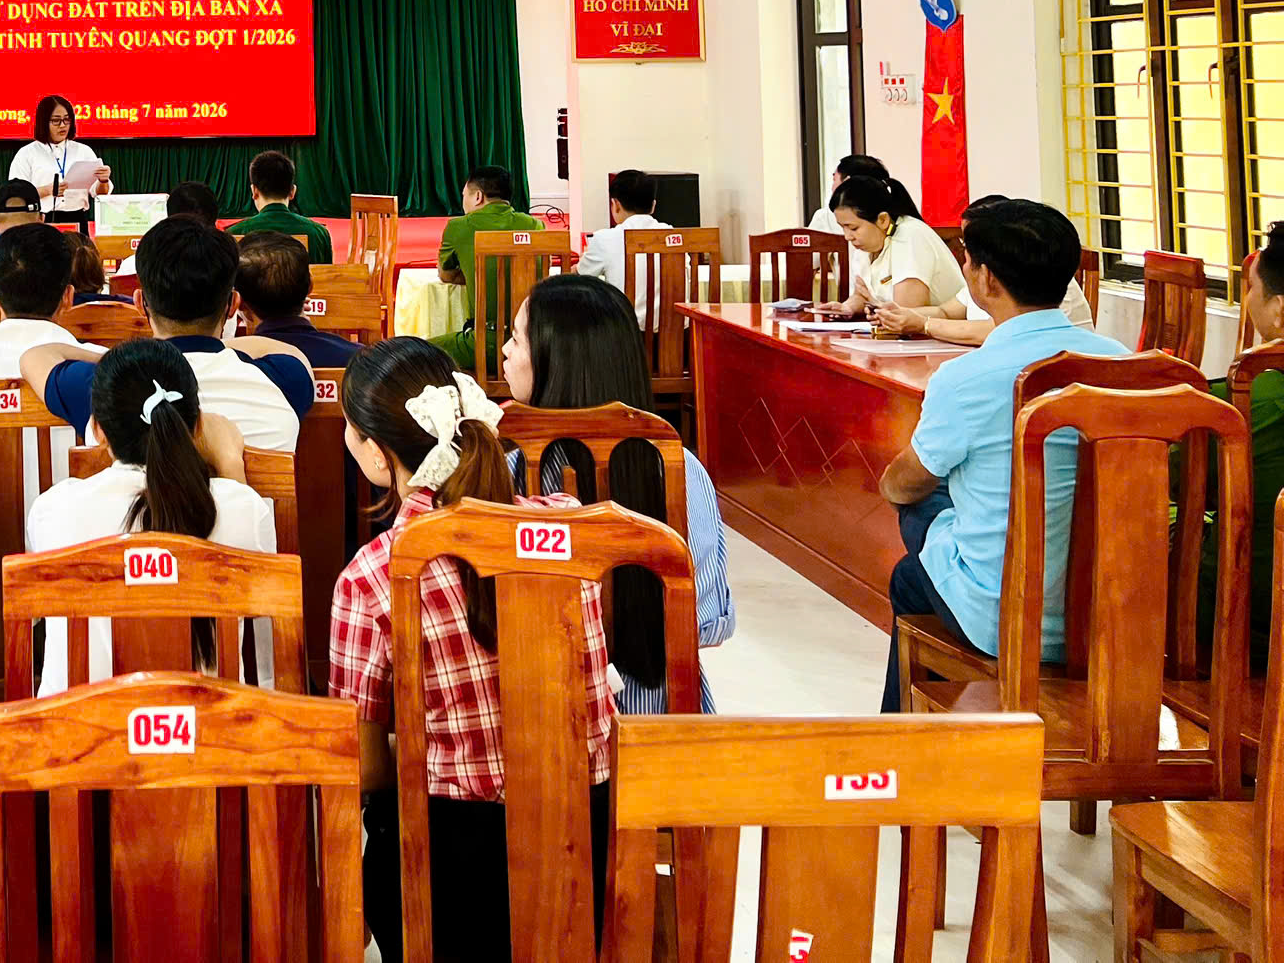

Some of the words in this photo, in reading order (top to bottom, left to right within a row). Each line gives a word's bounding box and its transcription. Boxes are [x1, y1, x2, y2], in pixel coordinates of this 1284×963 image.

[8, 2, 63, 23] DỤNG
[170, 0, 205, 21] ĐỊA
[47, 27, 113, 48] TUYÊN
[118, 31, 190, 50] QUANG
[196, 29, 237, 50] ĐỢT
[243, 29, 296, 46] 1/2026
[74, 105, 91, 120] 23
[96, 103, 139, 122] tháng
[142, 104, 150, 118] 7
[155, 104, 188, 118] năm
[192, 103, 228, 118] 2026
[514, 234, 528, 242] 071
[667, 236, 681, 244] 126
[793, 236, 808, 245] 065
[311, 301, 324, 313] 19
[316, 383, 335, 399] 32
[520, 528, 566, 553] 022
[129, 554, 172, 579] 040
[134, 714, 191, 745] 054
